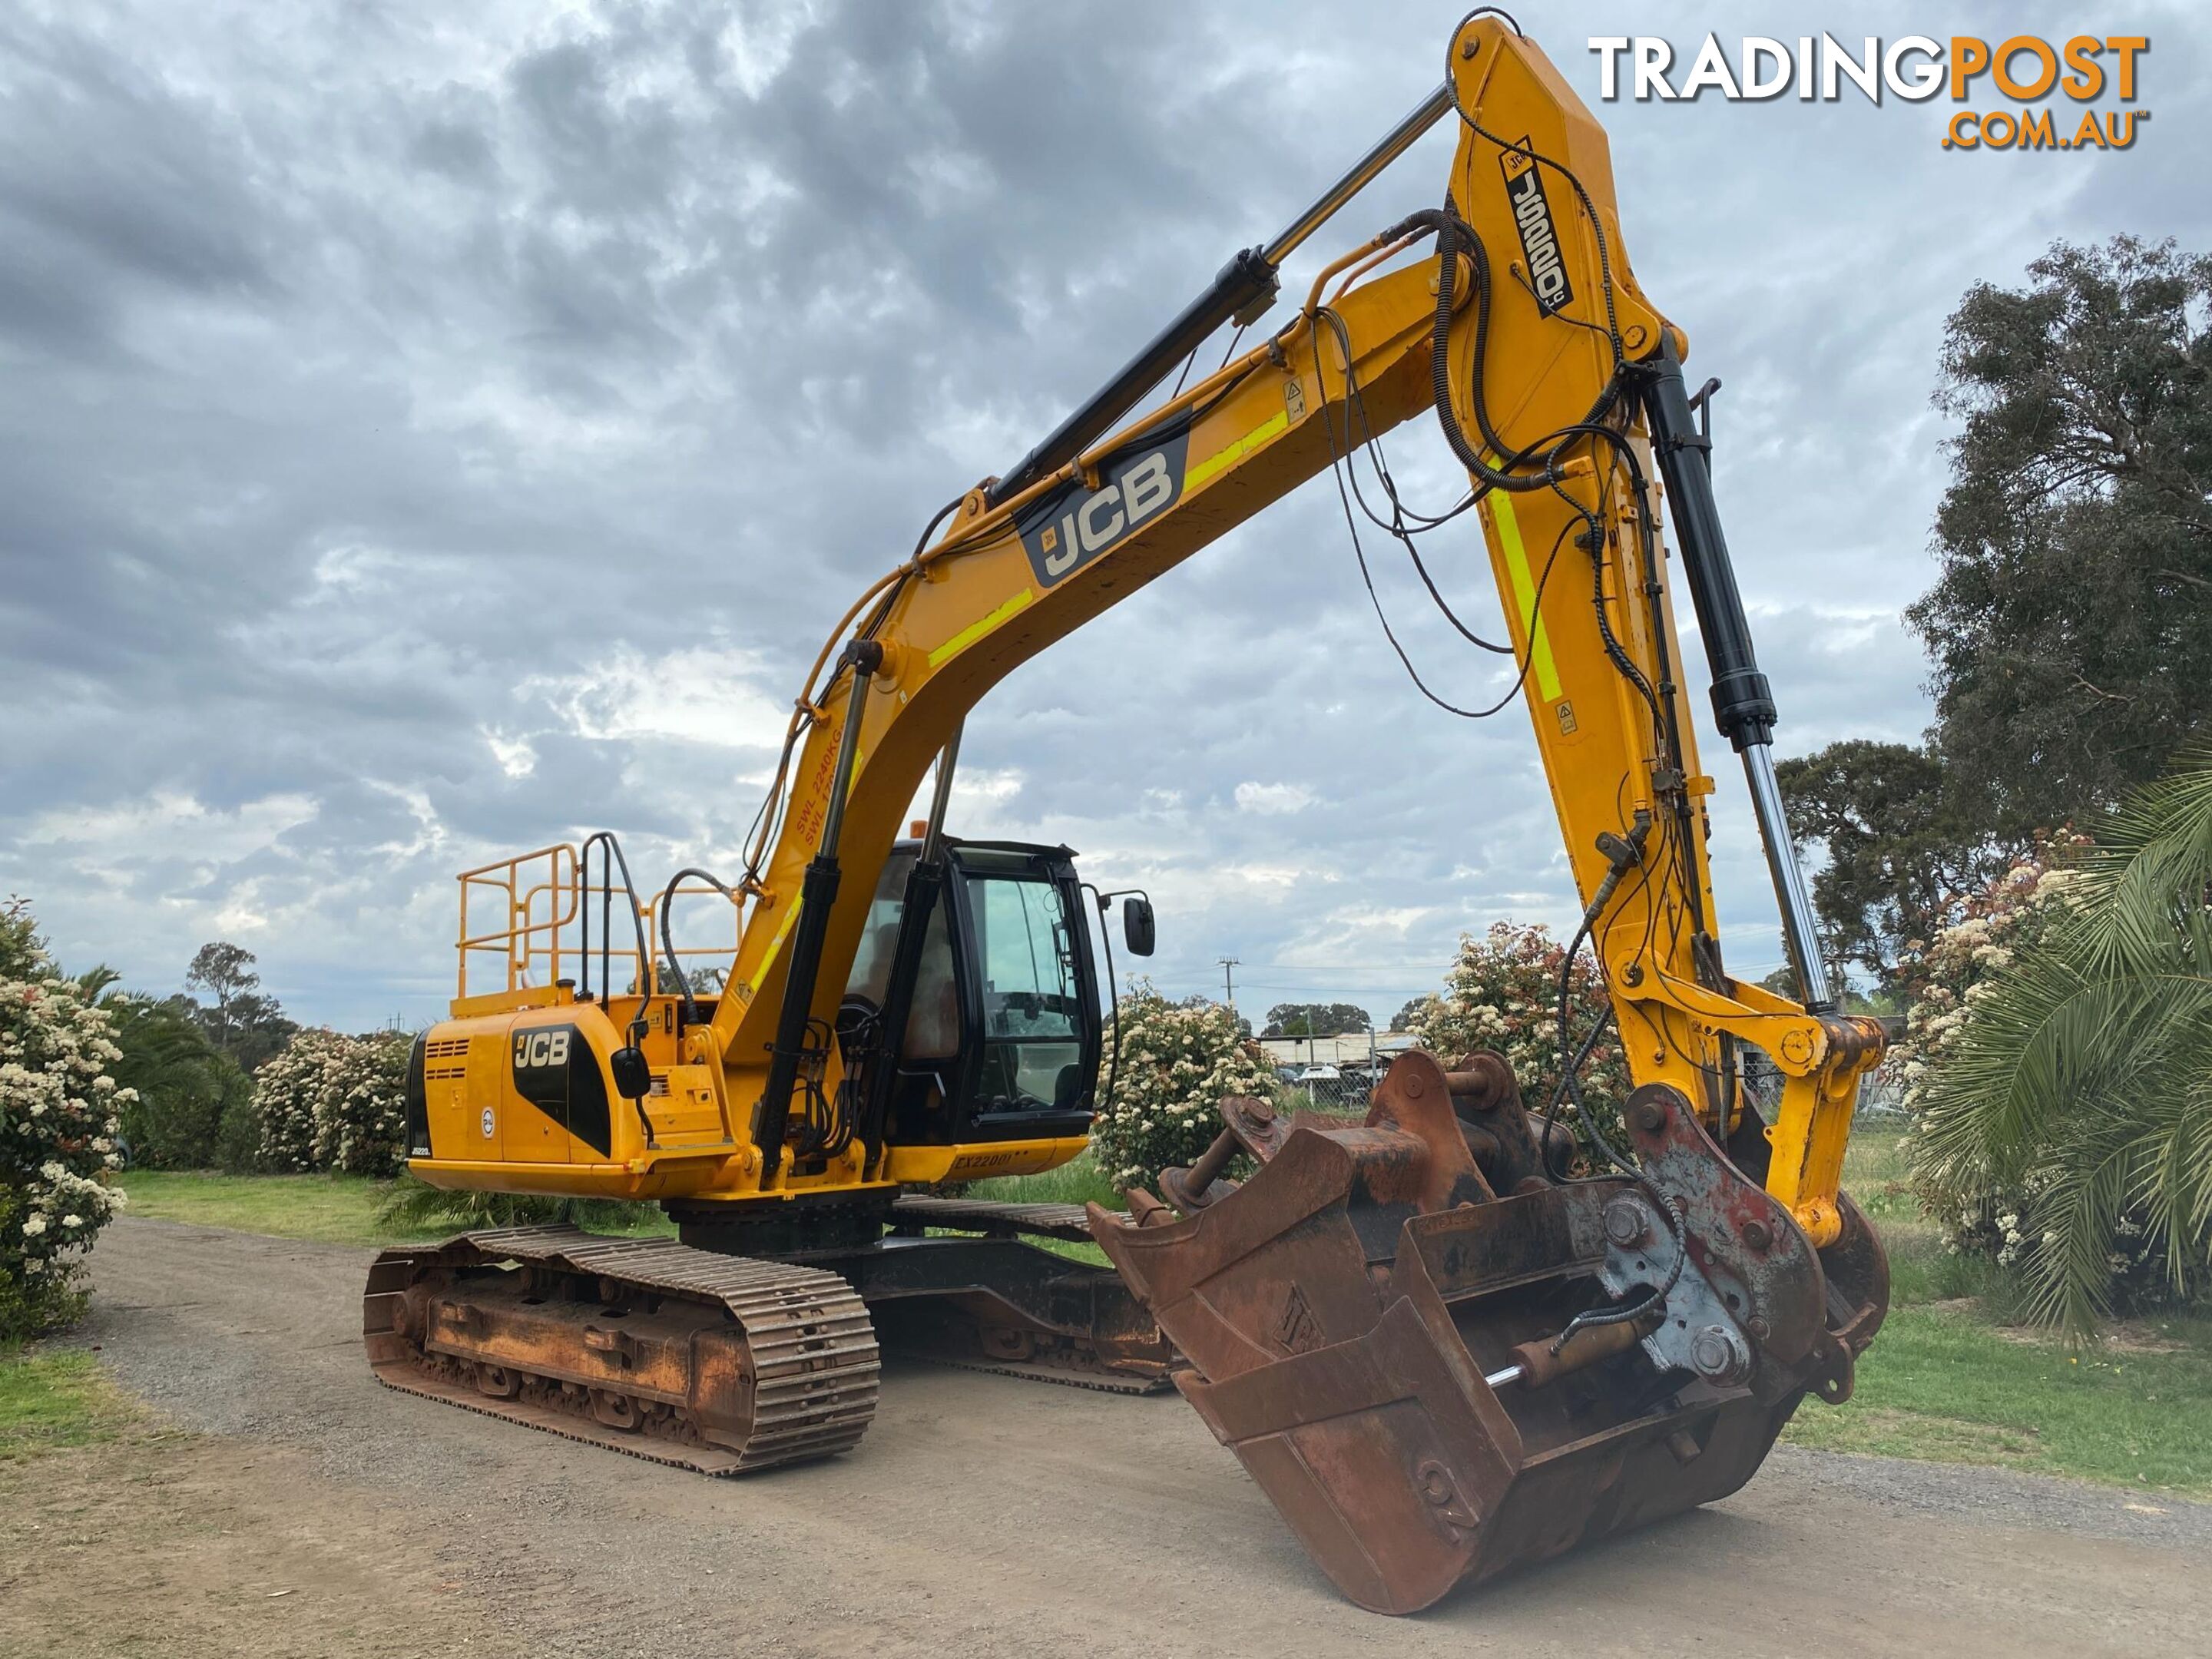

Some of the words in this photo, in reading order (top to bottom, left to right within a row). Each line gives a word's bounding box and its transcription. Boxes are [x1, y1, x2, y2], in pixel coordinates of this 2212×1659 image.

[1045, 452, 1172, 576] JCB
[796, 799, 816, 834] SWL
[806, 810, 824, 846] SWL
[515, 1031, 569, 1068] JCB
